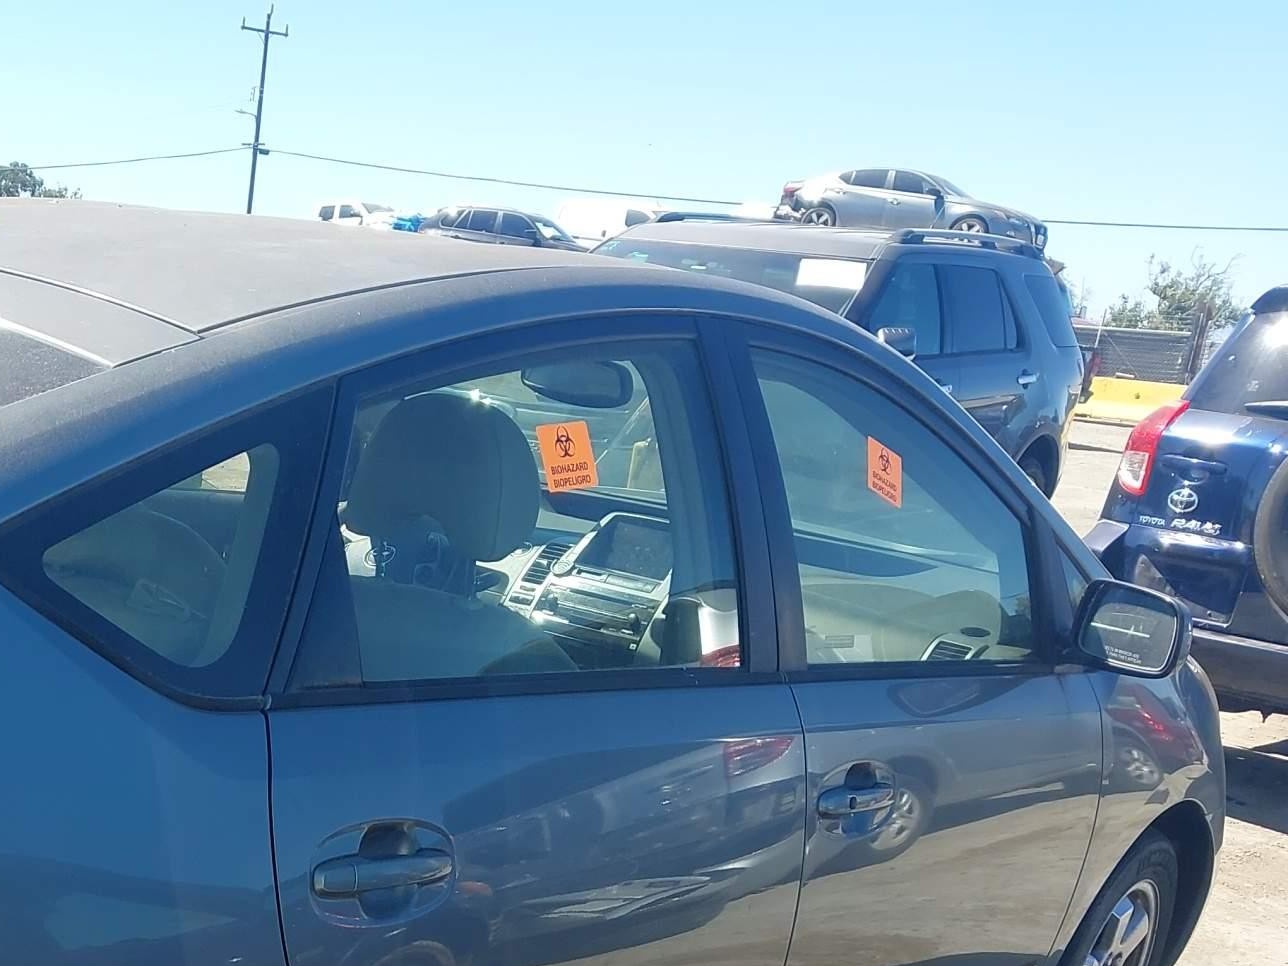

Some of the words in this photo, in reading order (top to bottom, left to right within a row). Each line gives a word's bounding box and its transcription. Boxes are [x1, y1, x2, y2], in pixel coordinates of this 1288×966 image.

[551, 461, 589, 475] BIOHAZARD
[553, 474, 592, 488] BIOPELIGRO
[1139, 515, 1166, 526] TOYOTA
